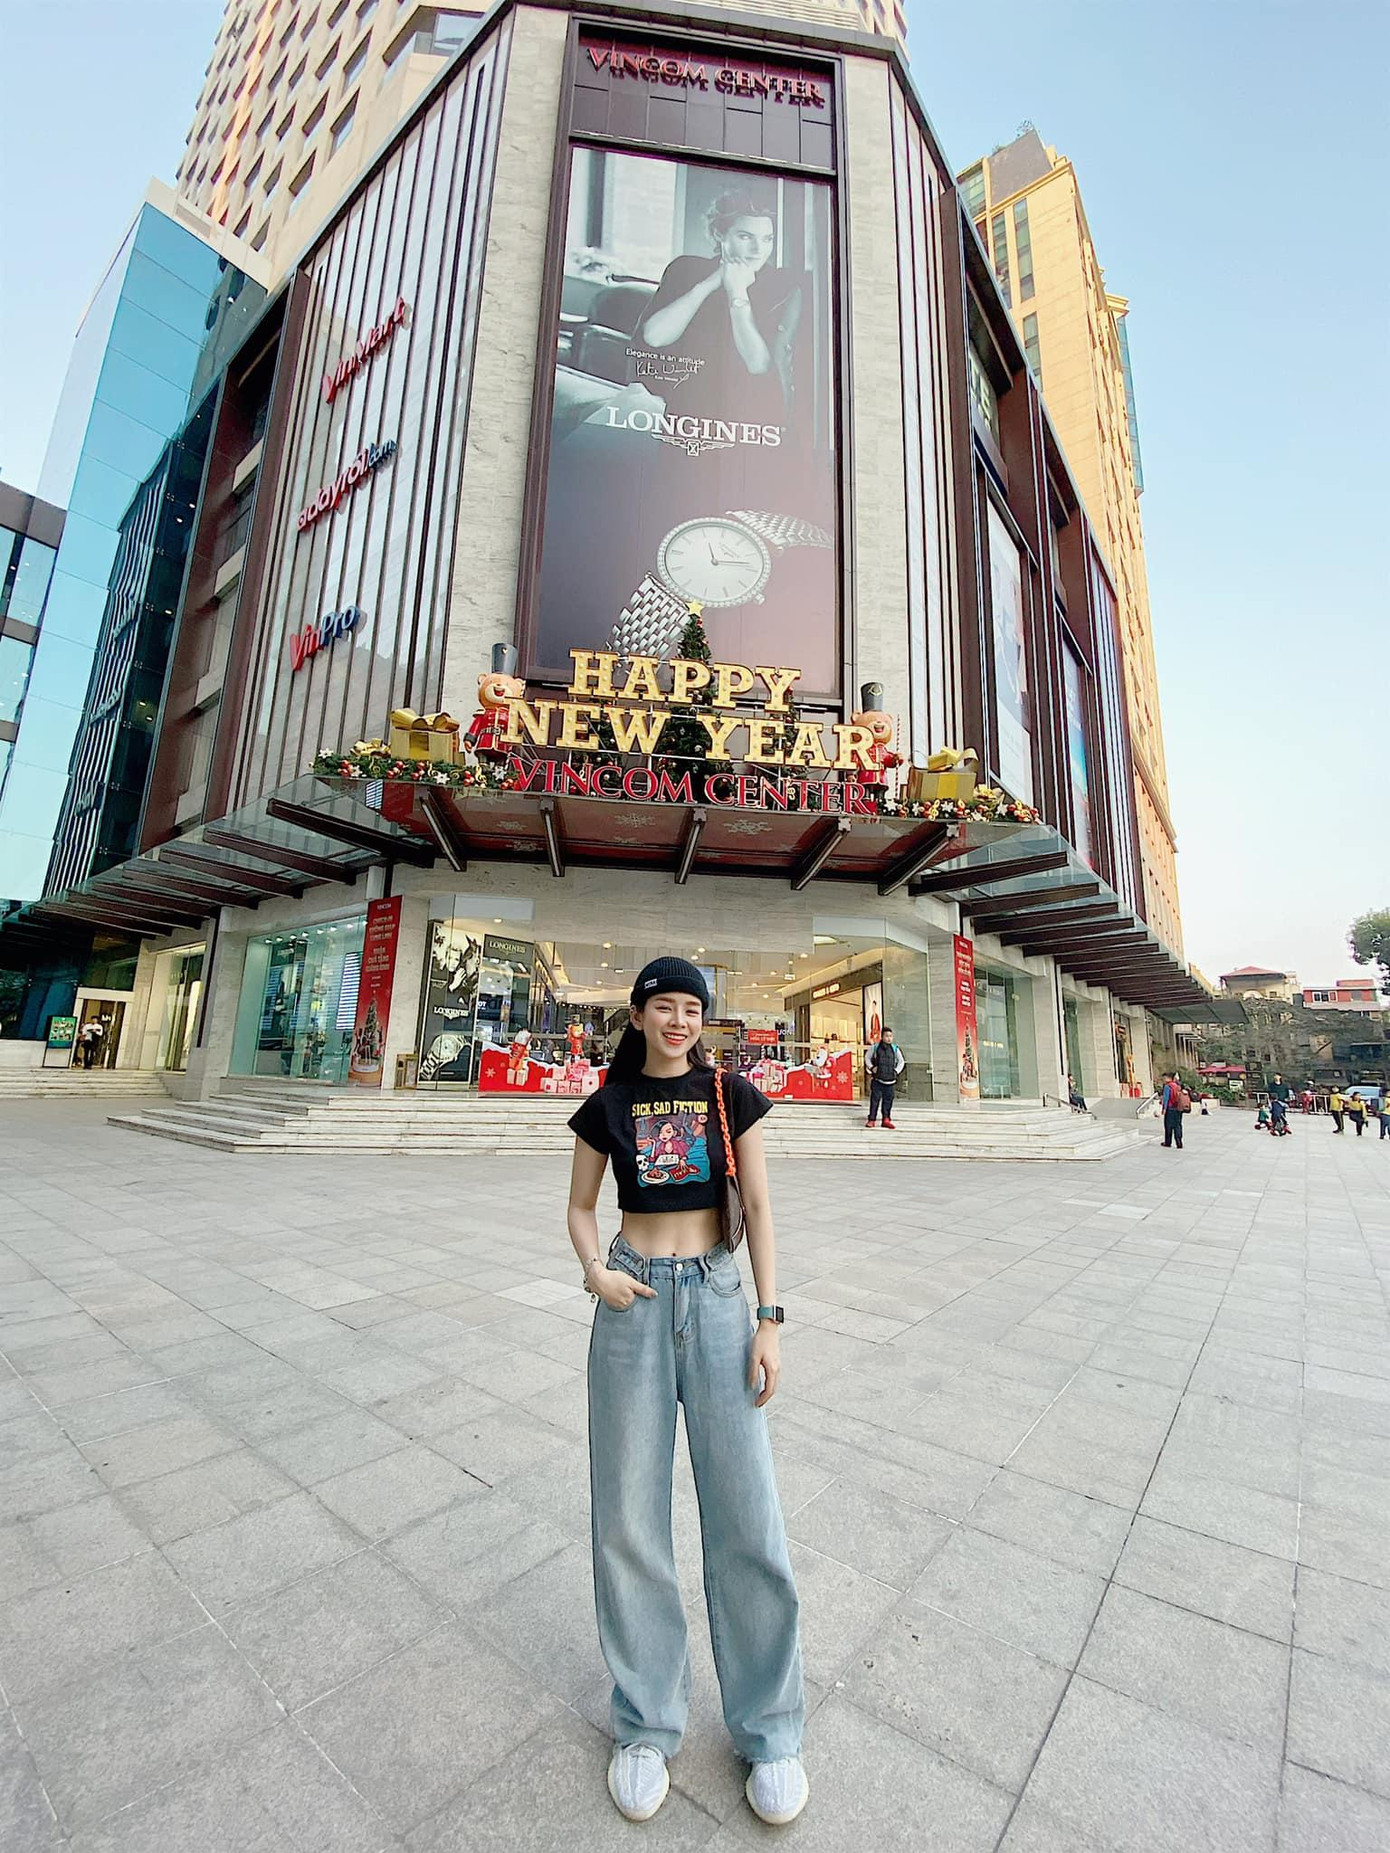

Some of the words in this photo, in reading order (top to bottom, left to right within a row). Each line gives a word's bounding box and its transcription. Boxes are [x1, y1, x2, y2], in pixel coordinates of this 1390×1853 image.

[587, 47, 705, 80] VINCOM
[714, 66, 822, 98] CENTER
[322, 297, 406, 404] VinMart
[626, 347, 659, 360] Elegance
[605, 406, 782, 447] LONGINES
[290, 605, 360, 672] VinPro
[568, 648, 802, 713] HAPPY
[500, 696, 672, 755] NEW
[696, 713, 883, 772] YEAR
[509, 756, 699, 805] VINCOM
[704, 772, 878, 816] CENTER
[653, 1101, 671, 1115] SAD
[673, 1100, 708, 1115] FICTION
